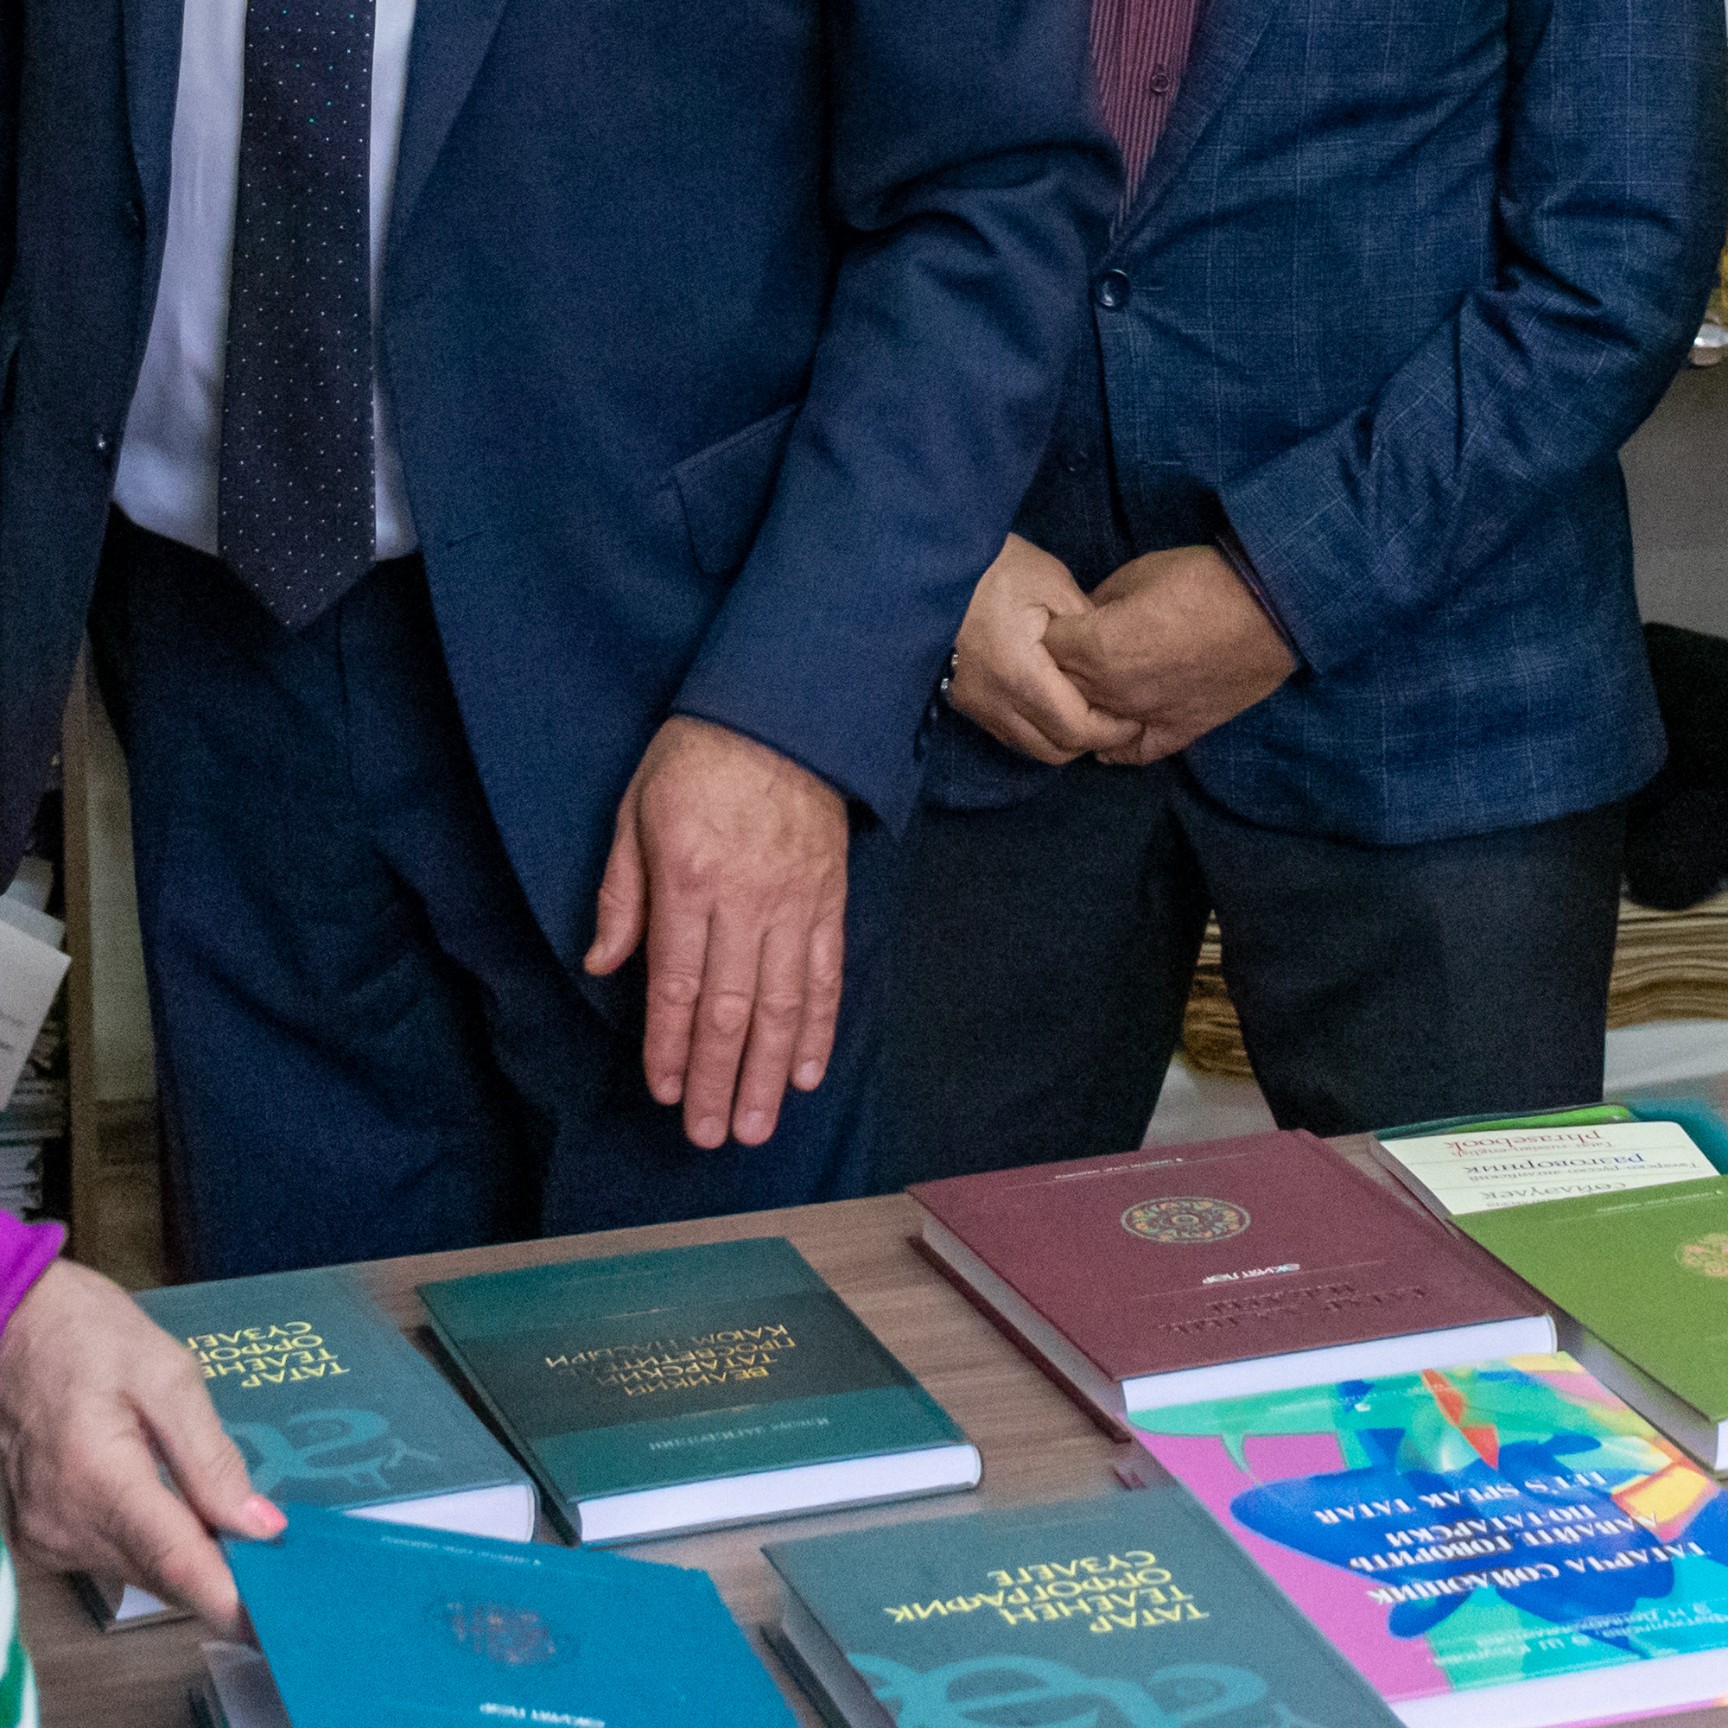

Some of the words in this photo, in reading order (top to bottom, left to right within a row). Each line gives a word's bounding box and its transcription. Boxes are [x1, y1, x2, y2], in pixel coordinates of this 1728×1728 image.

[1442, 1129, 1604, 1154] phrasebook
[1462, 1152, 1646, 1175] разговорник
[690, 1323, 789, 1346] КАЮМ
[202, 1347, 339, 1378] ТЕЛЕНЕ
[240, 1361, 350, 1388] ТАТАР
[623, 1366, 770, 1397] ВЕЛИКИЙ
[1313, 1494, 1413, 1526] TATAR
[1418, 1478, 1520, 1511] SPEAK
[1348, 1533, 1513, 1574] ГОВОРИТЬ
[1563, 1539, 1705, 1575] ТАТАРЧА
[882, 1567, 1172, 1623] ОРФОГРАФИК
[998, 1584, 1193, 1626] ТЕЛЕНЕН
[1089, 1602, 1211, 1634] ТАТАР
